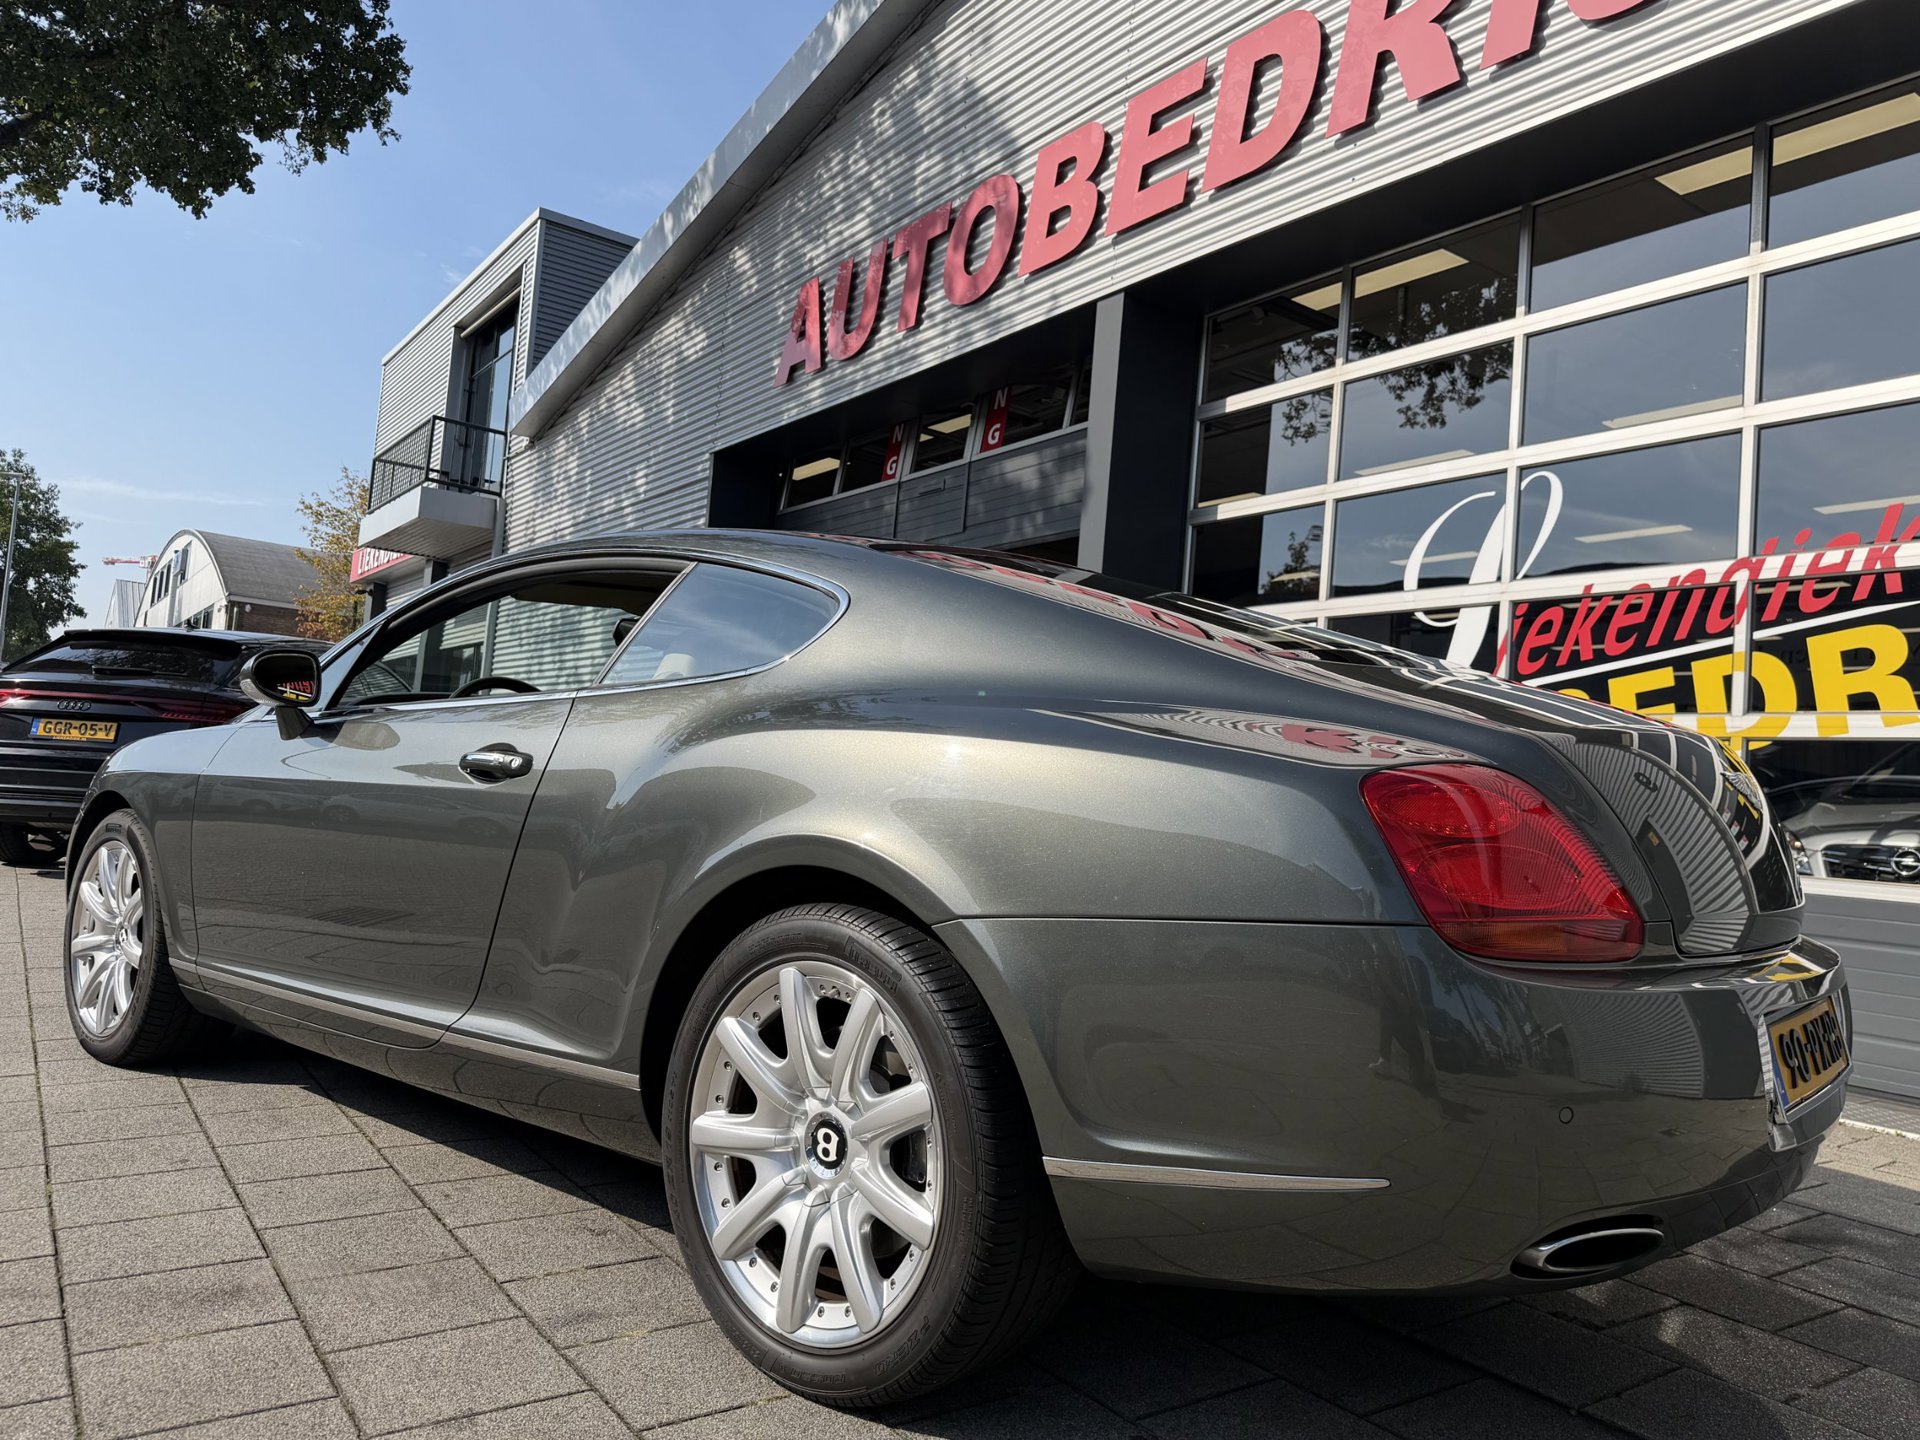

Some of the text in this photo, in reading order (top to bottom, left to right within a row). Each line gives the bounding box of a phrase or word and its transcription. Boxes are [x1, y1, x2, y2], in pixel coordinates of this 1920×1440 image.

[773, 0, 1645, 388] AUTOBEDR
[42, 720, 114, 737] GGR-05-V
[1553, 624, 1920, 750] EDR
